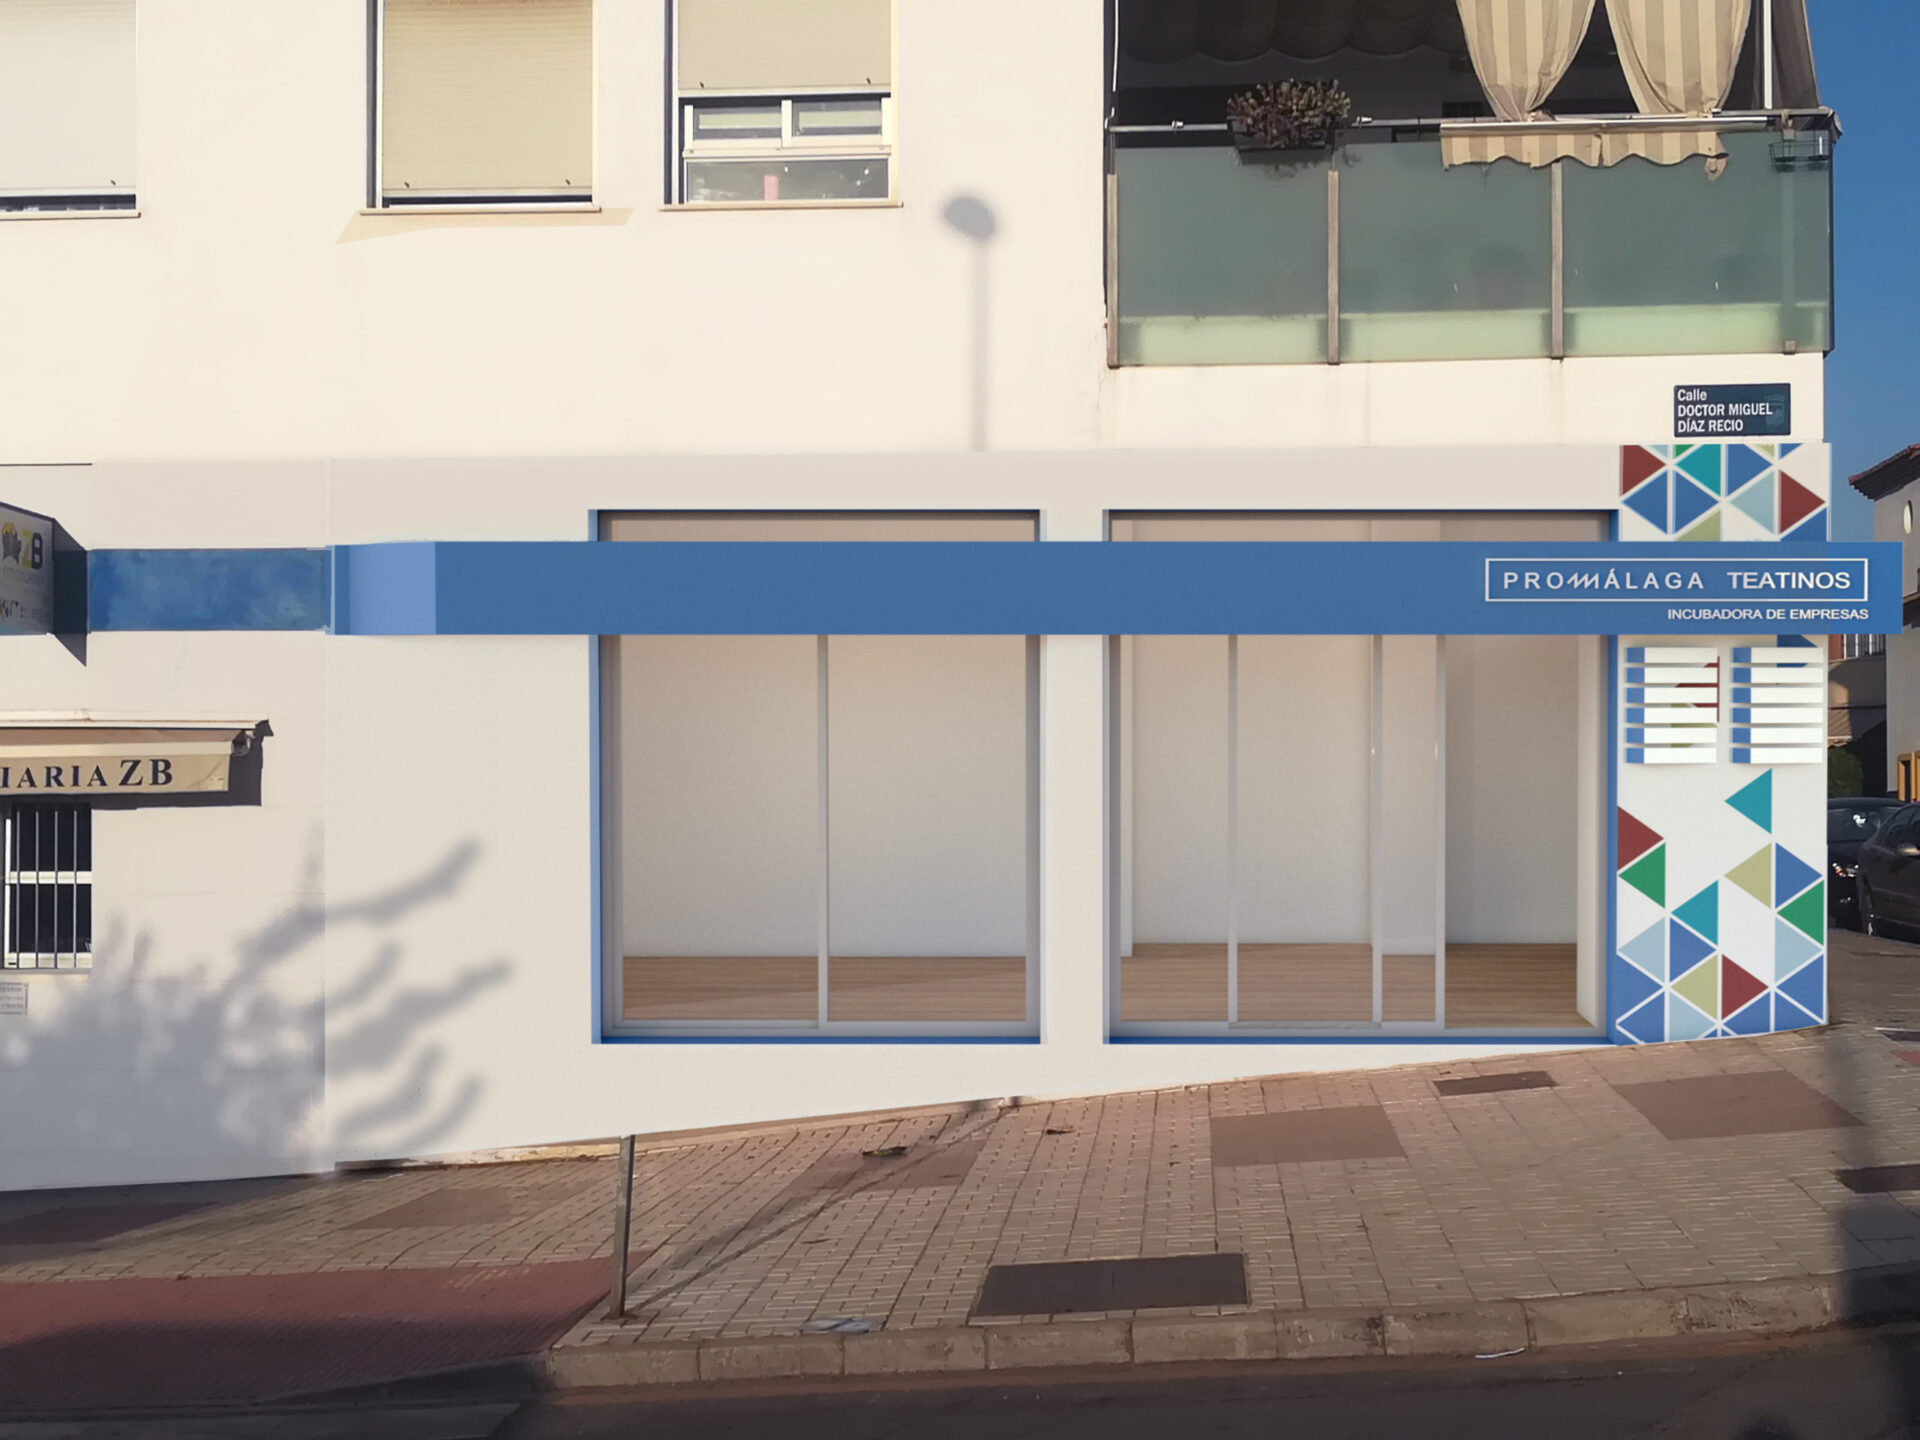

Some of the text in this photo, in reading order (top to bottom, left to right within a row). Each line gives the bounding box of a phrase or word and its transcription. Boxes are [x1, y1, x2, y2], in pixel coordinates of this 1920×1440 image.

[1677, 388, 1708, 402] Calle
[1677, 402, 1773, 417] DOCTOR MIGUEL
[1677, 418, 1744, 433] DÍAZ RECIO
[1503, 568, 1851, 589] PROMÁLAGA TEATINOS
[1667, 608, 1869, 620] INCUBADORA DE EMPRESAS
[118, 758, 173, 787] ZB
